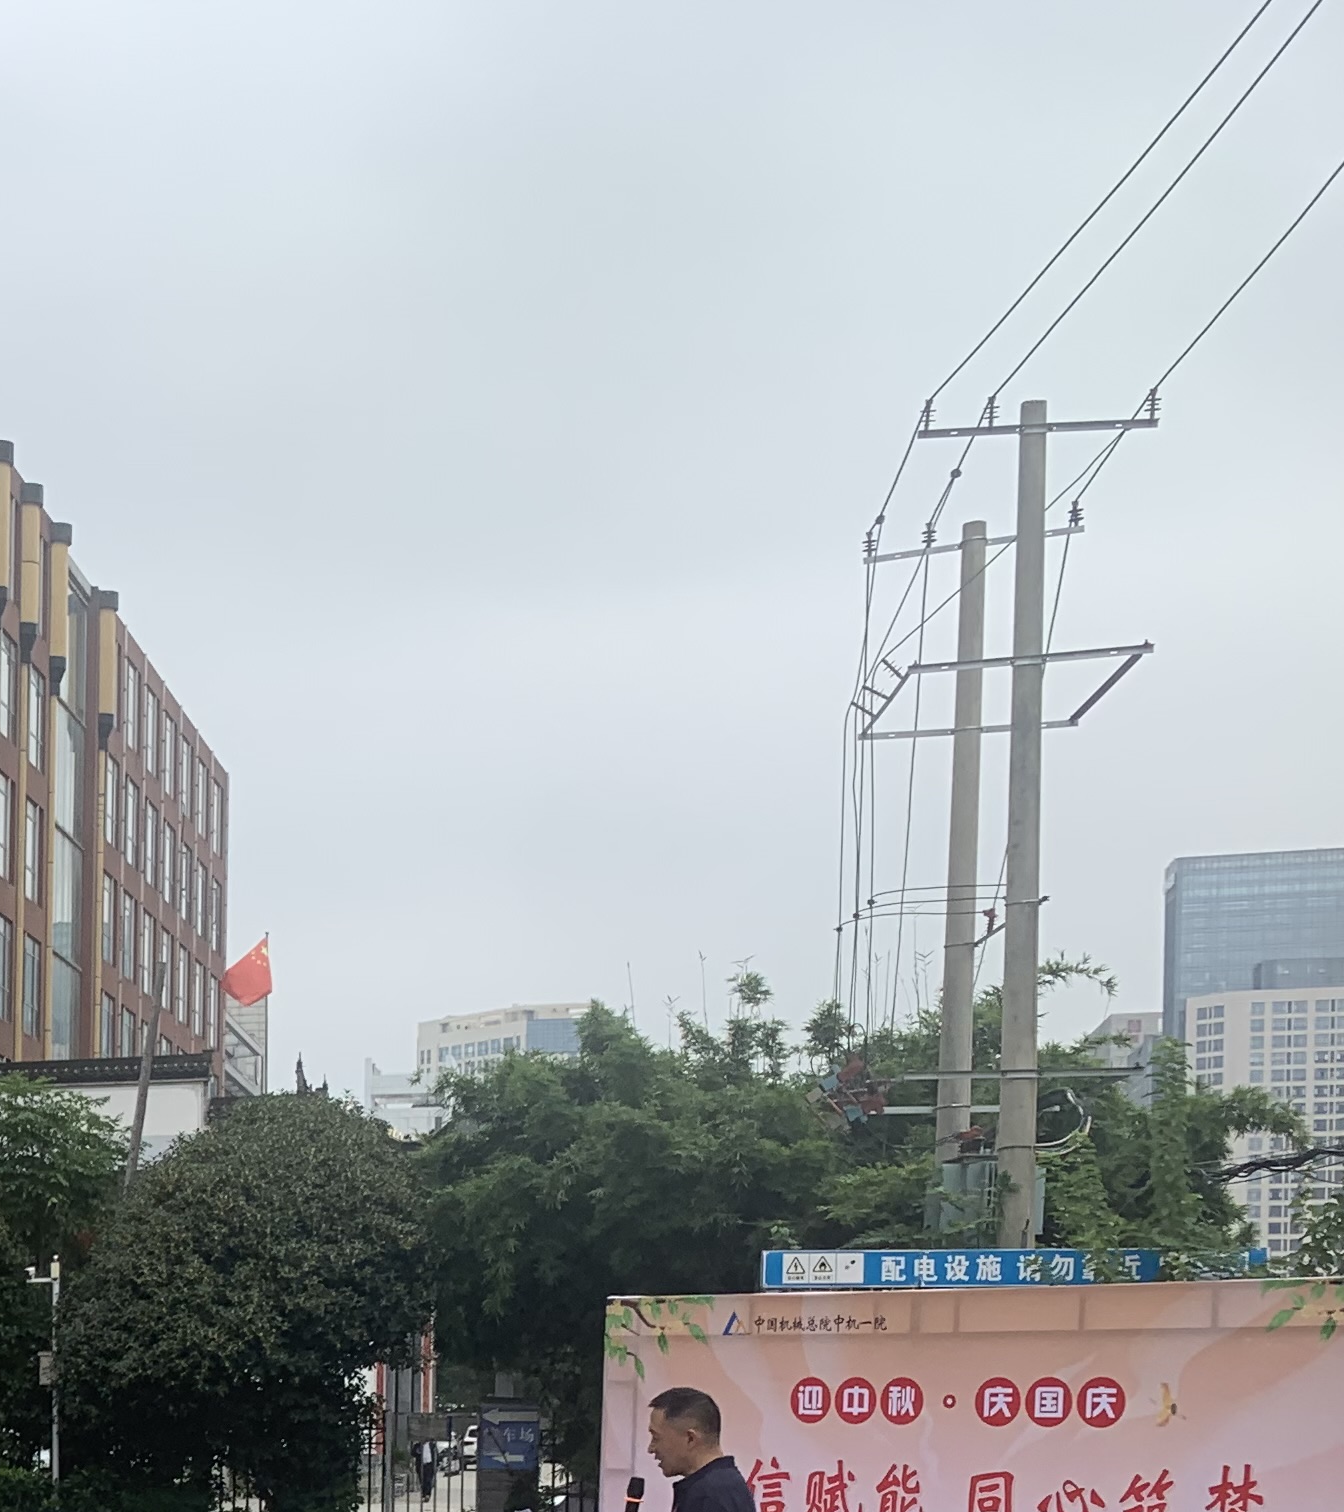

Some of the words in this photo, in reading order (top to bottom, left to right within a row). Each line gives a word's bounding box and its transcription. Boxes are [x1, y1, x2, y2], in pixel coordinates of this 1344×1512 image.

[880, 1254, 1002, 1282] 配电设施
[754, 1314, 888, 1334] 中国机械总院中机一院
